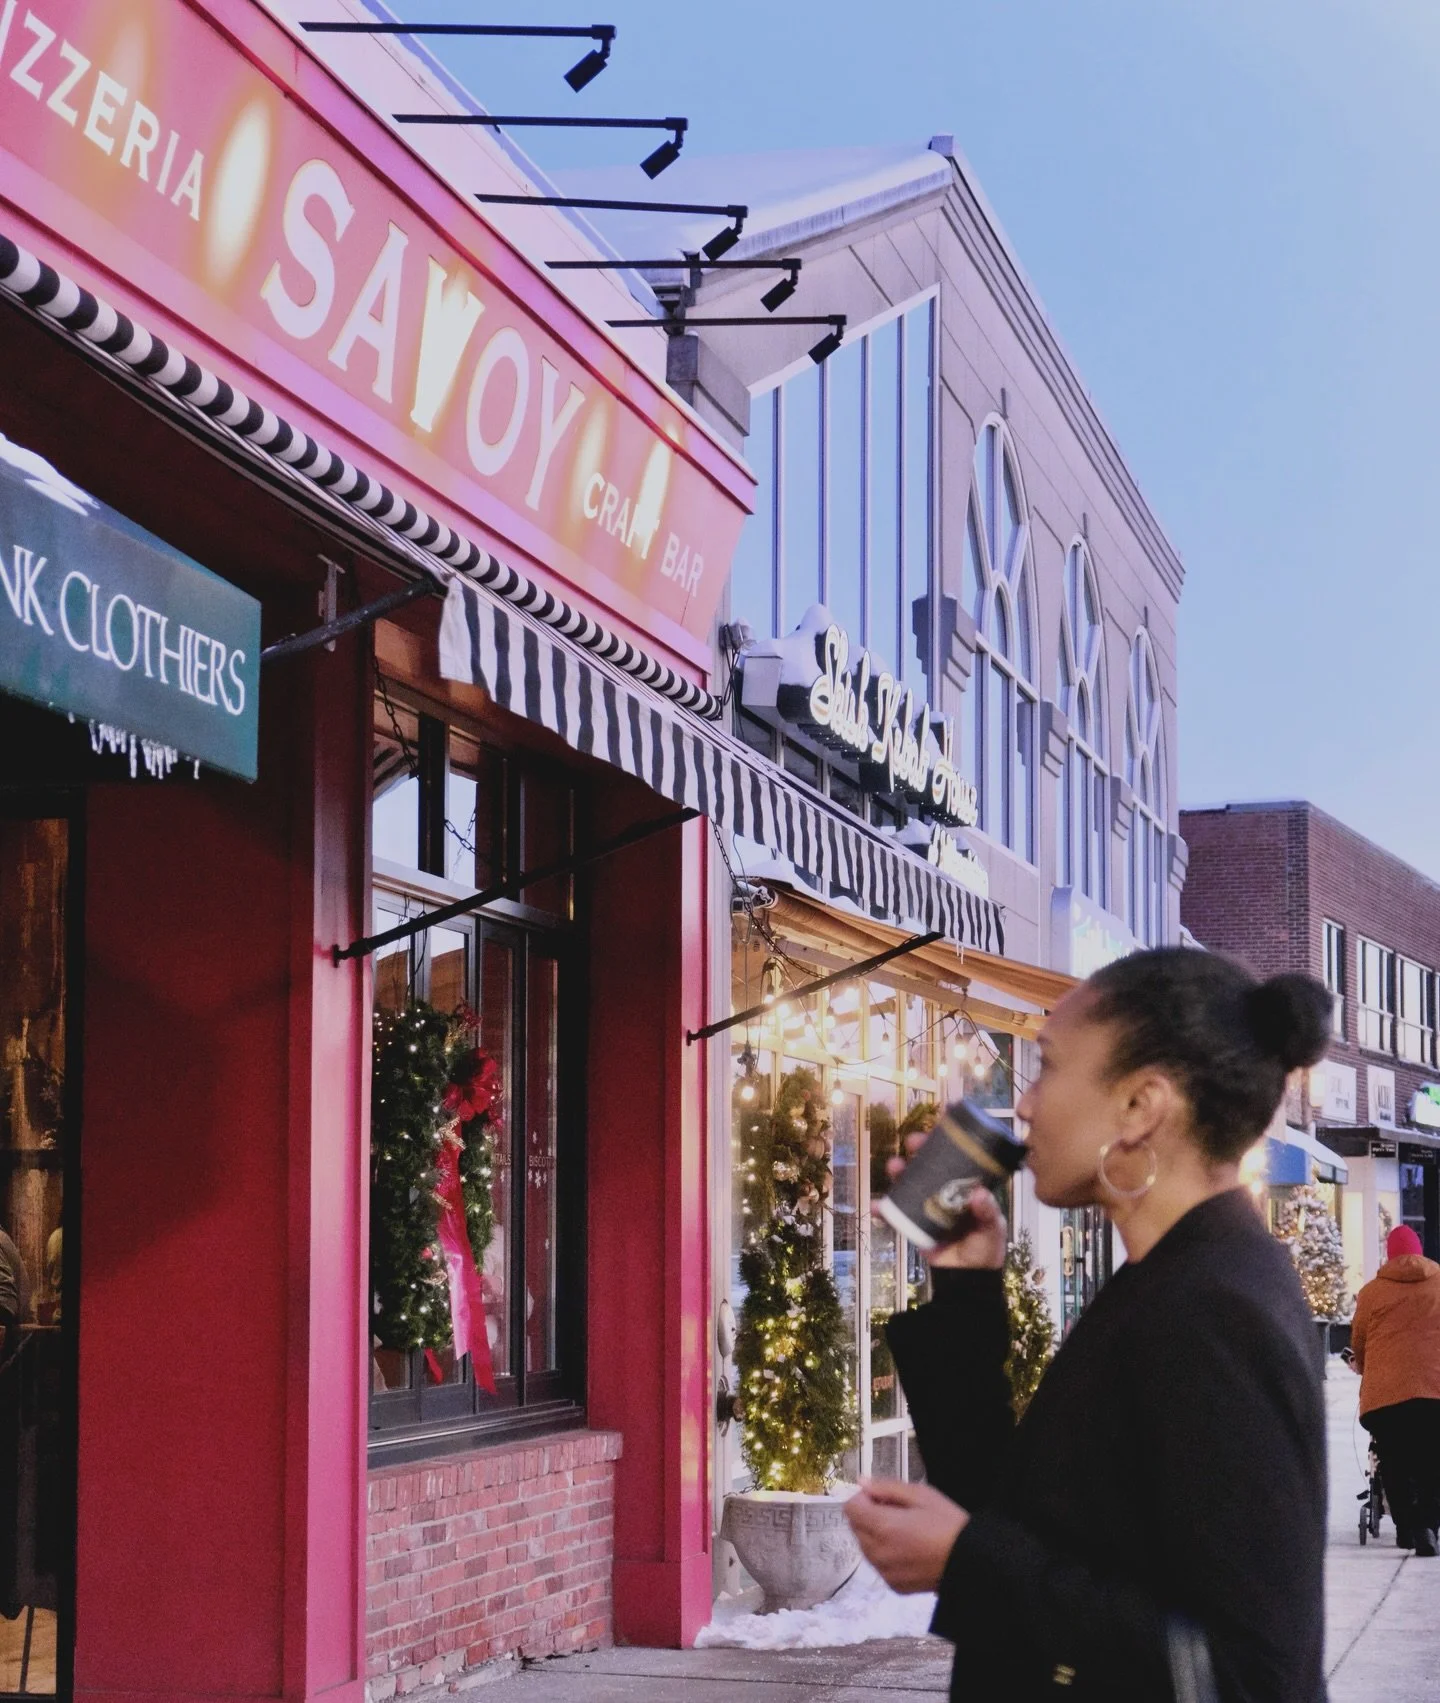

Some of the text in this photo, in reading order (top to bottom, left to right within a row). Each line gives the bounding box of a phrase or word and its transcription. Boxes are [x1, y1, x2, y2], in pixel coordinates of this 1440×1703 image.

[260, 158, 586, 512] SAVOY
[660, 531, 704, 598] BAR
[60, 571, 246, 716] CLOTHIERS
